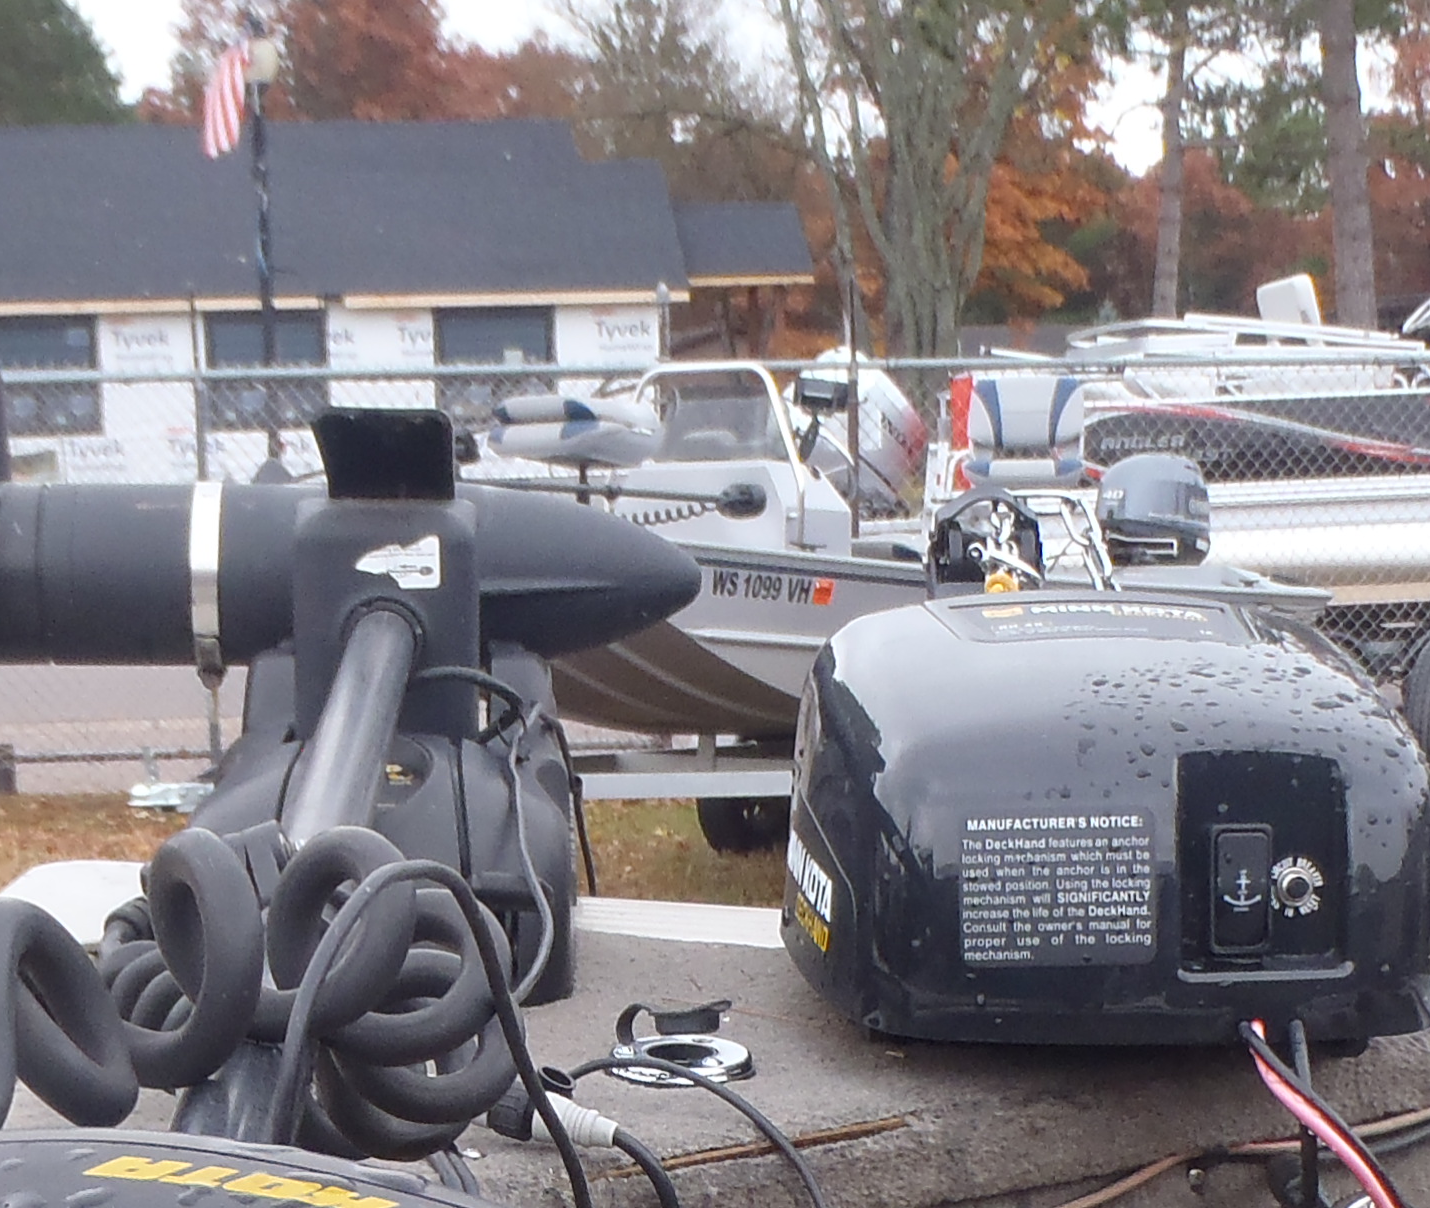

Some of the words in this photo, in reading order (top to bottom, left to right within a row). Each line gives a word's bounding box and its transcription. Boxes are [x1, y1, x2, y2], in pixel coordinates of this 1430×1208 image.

[595, 320, 651, 342] Tyvek
[1100, 435, 1185, 450] ANGLER
[712, 569, 739, 597] WS
[743, 573, 782, 601] 1099
[787, 577, 812, 604] VH
[967, 817, 1087, 831] MANUFACTURER'S
[1090, 816, 1143, 828] NOTICE:
[962, 839, 982, 850] The
[985, 838, 1046, 849] DeckHand
[1048, 837, 1093, 848] features
[1095, 839, 1108, 847] an
[1112, 836, 1150, 847] anchor
[962, 854, 1001, 866] locking
[1004, 853, 1066, 863] mechanism
[1071, 852, 1103, 861] which
[1106, 851, 1133, 861] must
[1136, 850, 1150, 860] be
[962, 867, 989, 878] used
[996, 866, 1025, 877] when
[1032, 866, 1050, 876] the
[1056, 865, 1094, 875] anchor
[1101, 864, 1110, 874] is
[1116, 864, 1127, 874] in
[1133, 864, 1150, 874] the
[801, 850, 832, 924] KOTA
[963, 881, 1001, 891] stowed
[1056, 880, 1087, 891] Using
[1091, 879, 1109, 889] the
[1112, 878, 1150, 890] locking
[963, 895, 1026, 905] mechanism
[1032, 894, 1051, 904] will
[1057, 891, 1150, 903] SIGNIFICANTLY
[962, 909, 1009, 919] increase
[1013, 908, 1029, 918] the
[1032, 907, 1049, 917] life
[1052, 907, 1063, 917] of
[1068, 906, 1085, 916] the
[1088, 905, 1151, 916] DeckHand.
[962, 922, 1006, 933] Consult
[1013, 921, 1031, 932] the
[1038, 921, 1083, 931] owner's
[1089, 920, 1130, 930] manual
[1136, 919, 1152, 929] for
[964, 936, 1006, 948] proper
[1017, 936, 1040, 946] use
[1051, 934, 1064, 944] of
[1075, 934, 1095, 944] the
[1106, 933, 1152, 945] locking
[964, 950, 1034, 961] mechanism.
